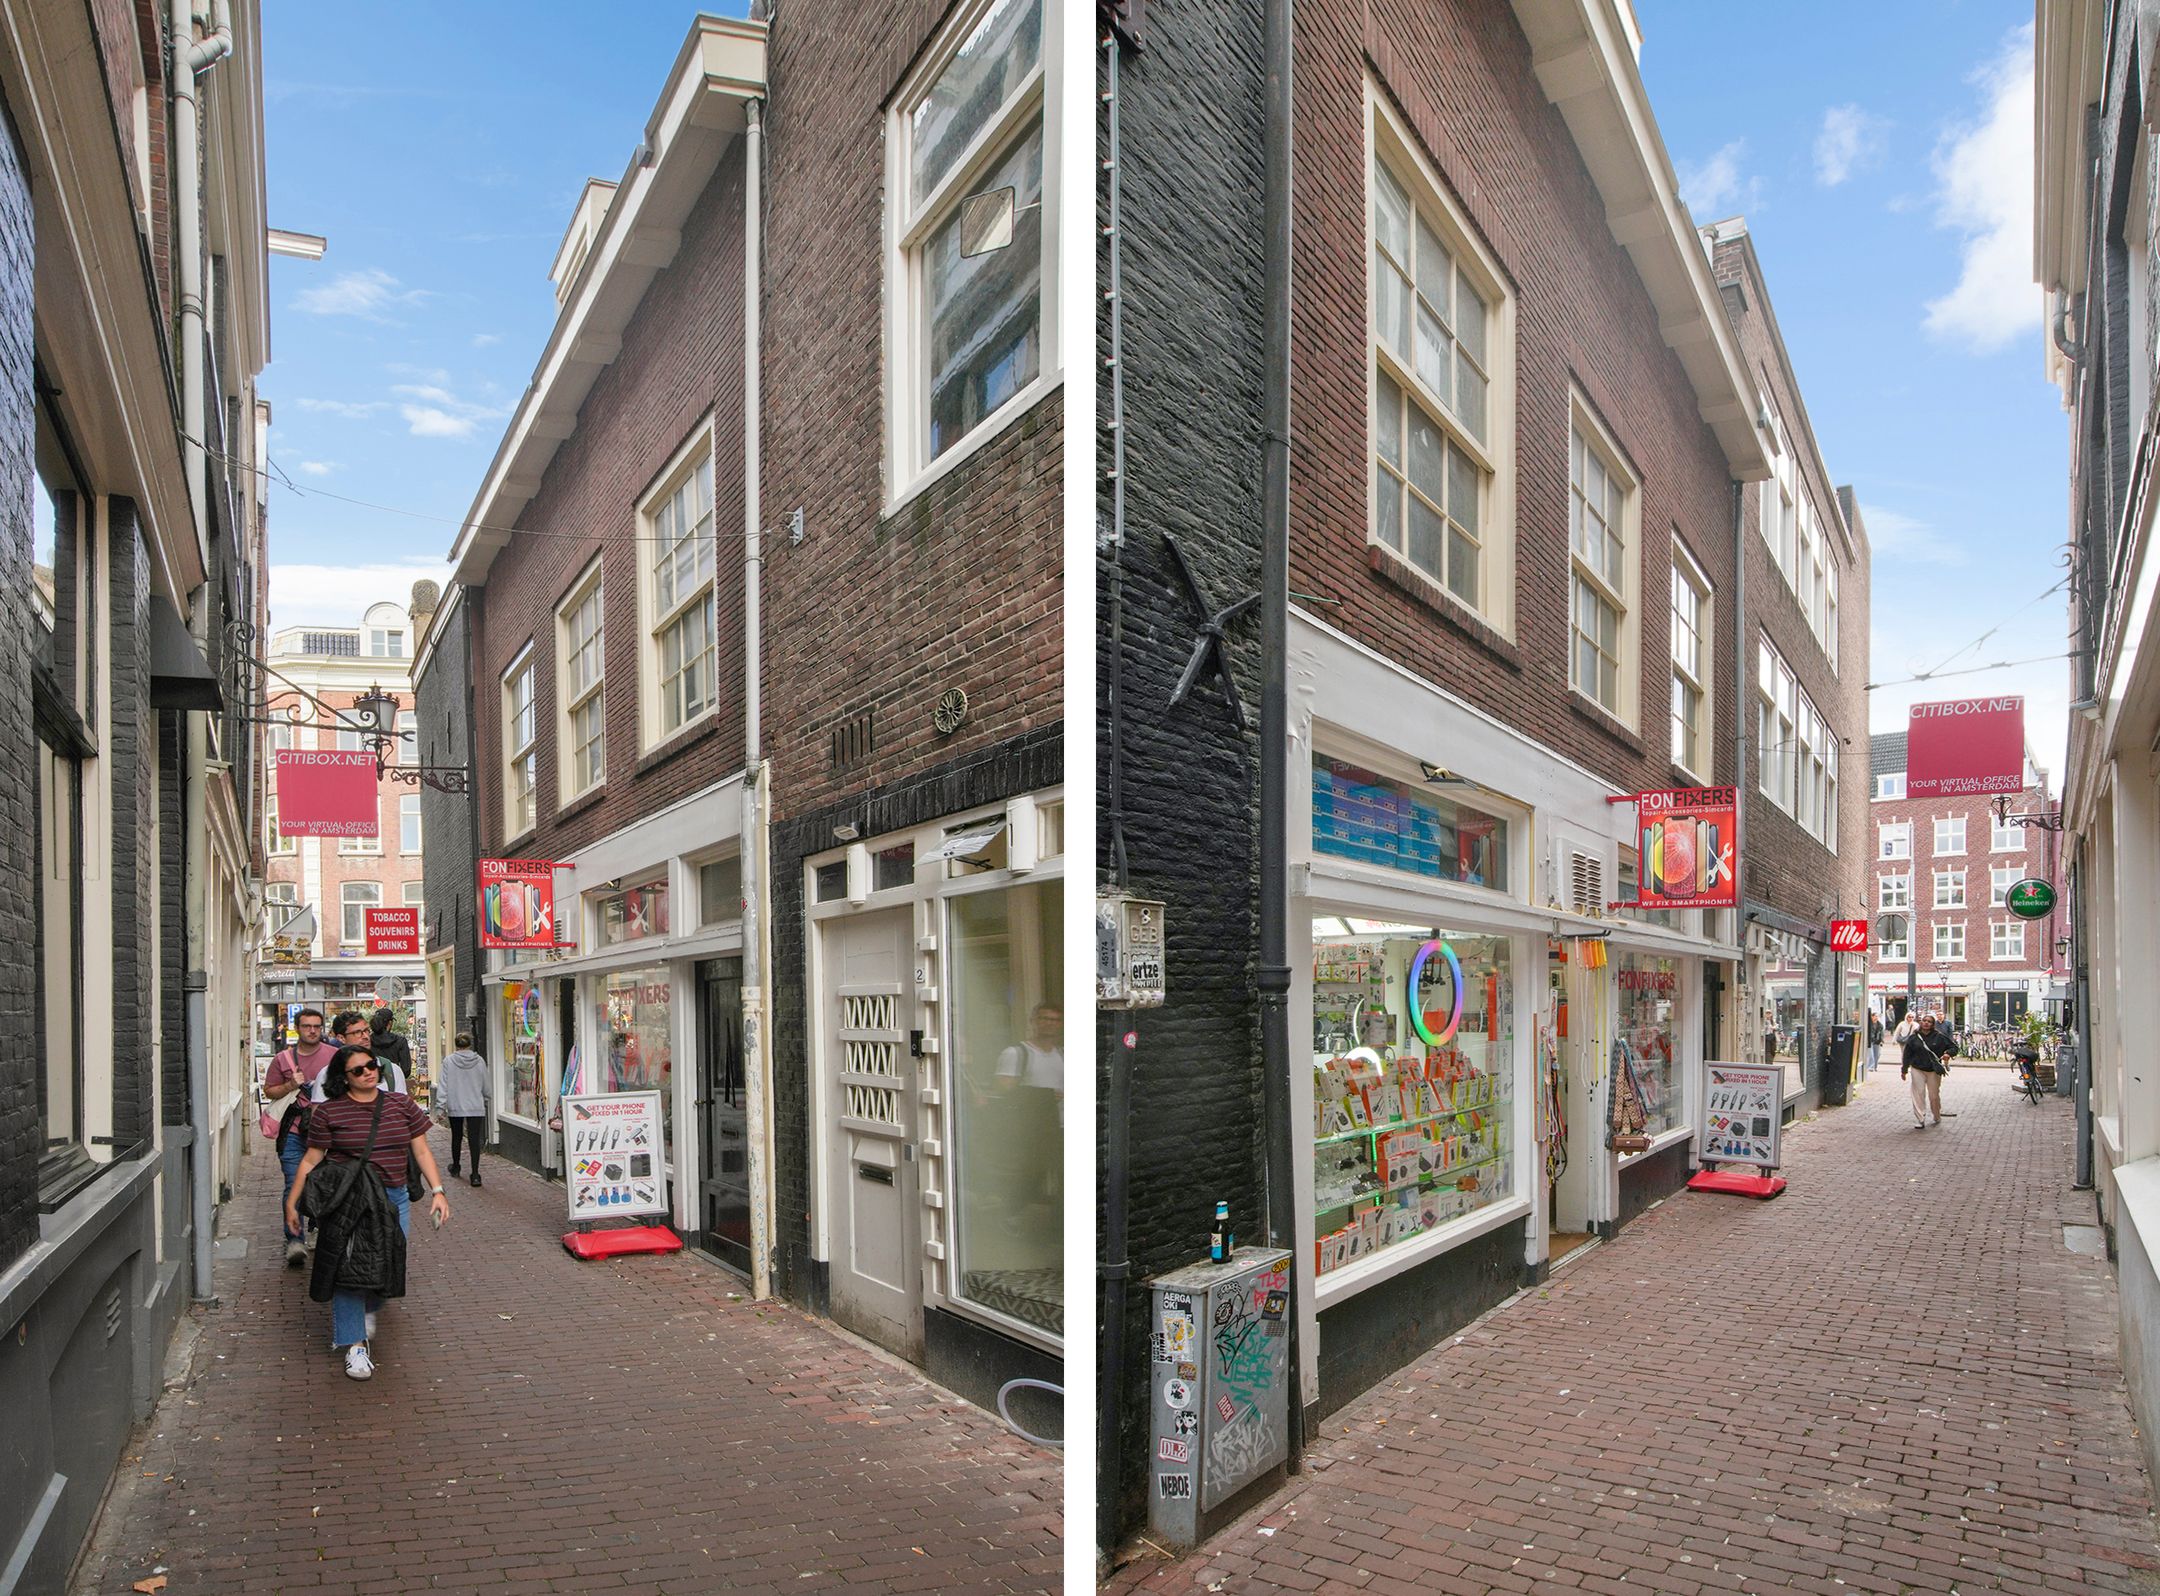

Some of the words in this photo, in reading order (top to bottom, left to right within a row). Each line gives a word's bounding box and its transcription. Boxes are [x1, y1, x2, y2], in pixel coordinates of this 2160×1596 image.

[1910, 698, 2021, 719] CITIBOX.NET
[277, 752, 376, 766] CITIBOX.NET
[1910, 780, 1937, 788] YOUR
[1940, 777, 1980, 787] VIRTUAL
[1983, 775, 2020, 784] OFFICE
[1953, 782, 2020, 792] AMSTERDAM
[307, 821, 344, 829] VIRTUAL
[345, 821, 377, 829] OFFICE
[2012, 899, 2049, 907] Heineken
[372, 912, 411, 923] TOBACCO
[369, 926, 415, 936] SOUVENIRS
[1833, 925, 1865, 948] illy
[377, 940, 408, 950] DRINKS
[916, 969, 923, 980] 2
[1133, 962, 1159, 979] ertze
[601, 1103, 620, 1111] YOUR
[1164, 1291, 1192, 1304] AERGA
[1216, 1395, 1234, 1422] RICK
